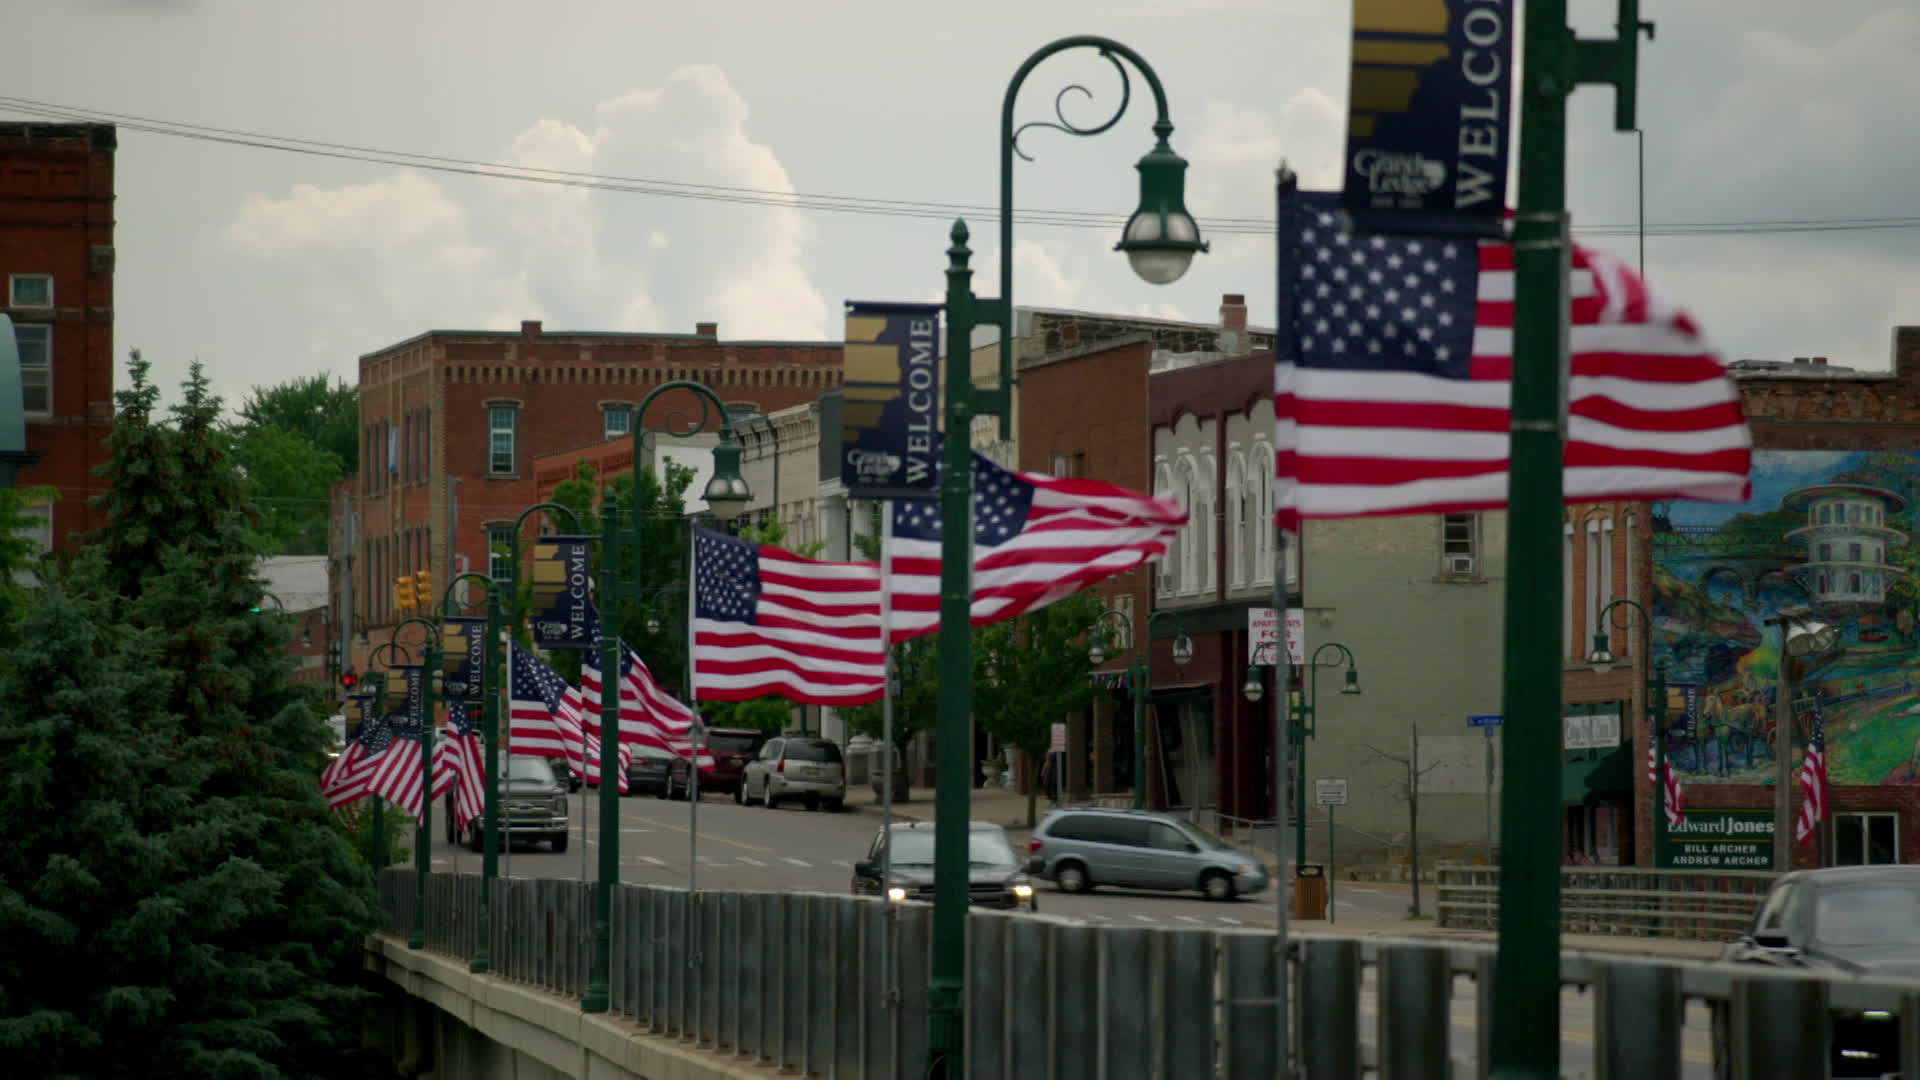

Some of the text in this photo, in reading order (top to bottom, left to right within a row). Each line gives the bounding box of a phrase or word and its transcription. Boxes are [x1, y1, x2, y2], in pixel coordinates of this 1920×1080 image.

[1454, 0, 1502, 209] WELCO
[906, 319, 933, 484] WELCOME
[571, 544, 585, 639] WELCOME
[470, 624, 482, 695] WELCOME
[1672, 856, 1769, 865] ANDREW ARCHER
[1684, 843, 1758, 853] BILL ARCHER
[1726, 816, 1776, 835] Jones
